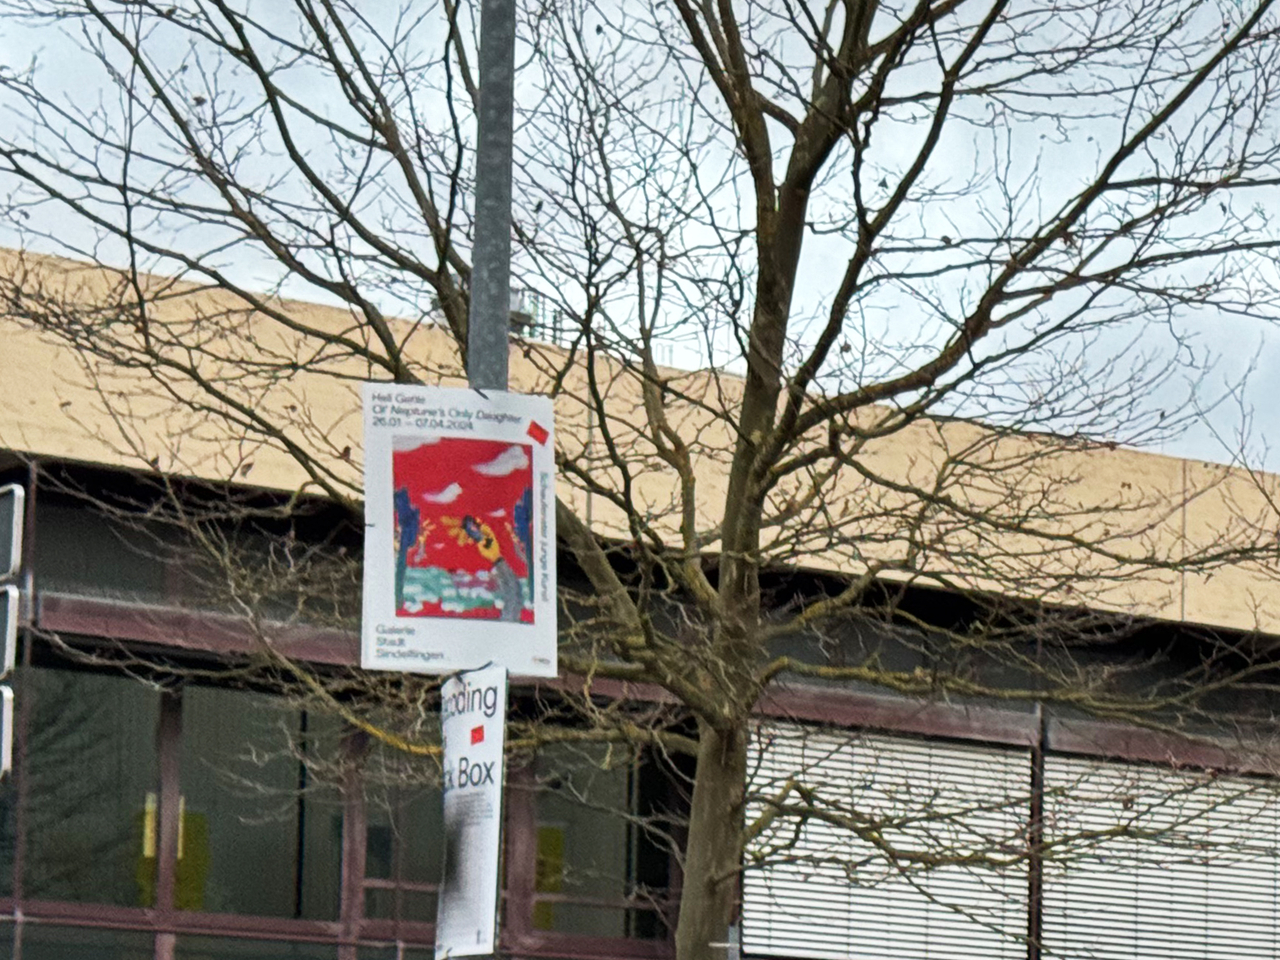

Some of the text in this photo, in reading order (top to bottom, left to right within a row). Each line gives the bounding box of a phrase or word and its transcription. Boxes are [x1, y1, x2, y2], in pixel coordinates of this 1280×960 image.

[448, 408, 474, 420] Only
[476, 410, 522, 424] Daughter
[376, 624, 416, 636] Galerie
[376, 636, 405, 647] Stadt
[376, 650, 444, 661] Sindelfingen
[458, 757, 496, 789] Box
